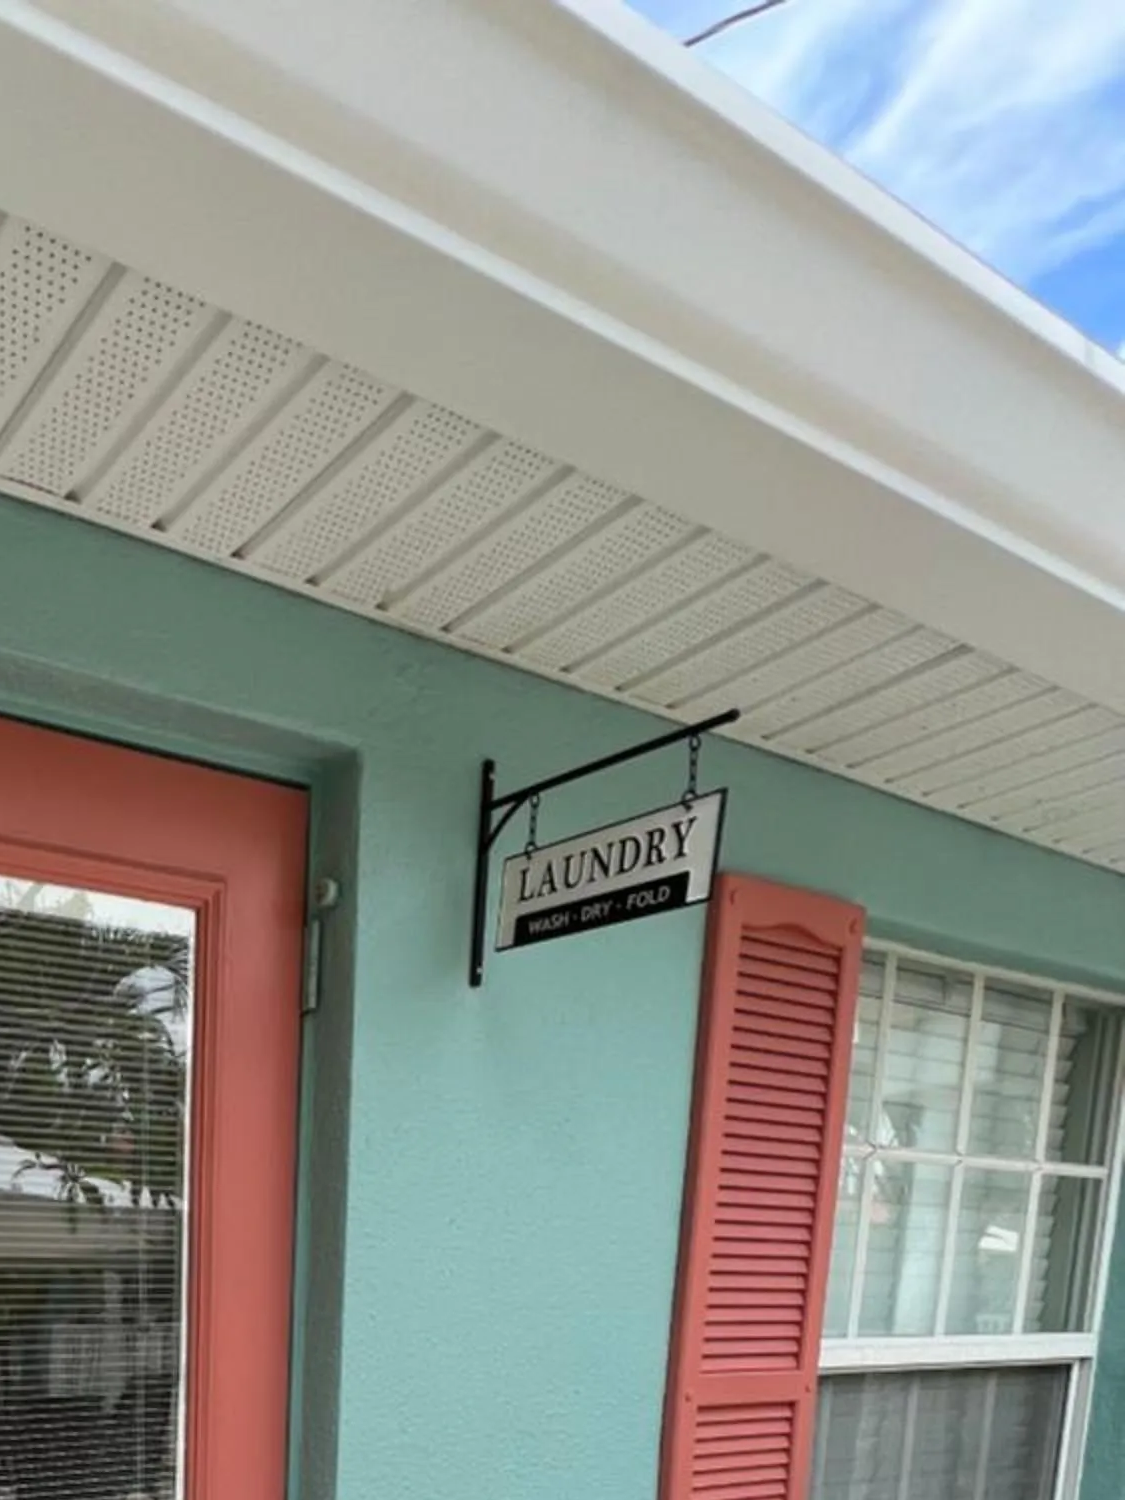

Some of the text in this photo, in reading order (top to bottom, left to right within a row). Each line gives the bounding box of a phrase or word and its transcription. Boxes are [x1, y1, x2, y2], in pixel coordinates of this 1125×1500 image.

[518, 816, 698, 902] LAUNDRY
[528, 885, 670, 935] WASH DRY FOLD
